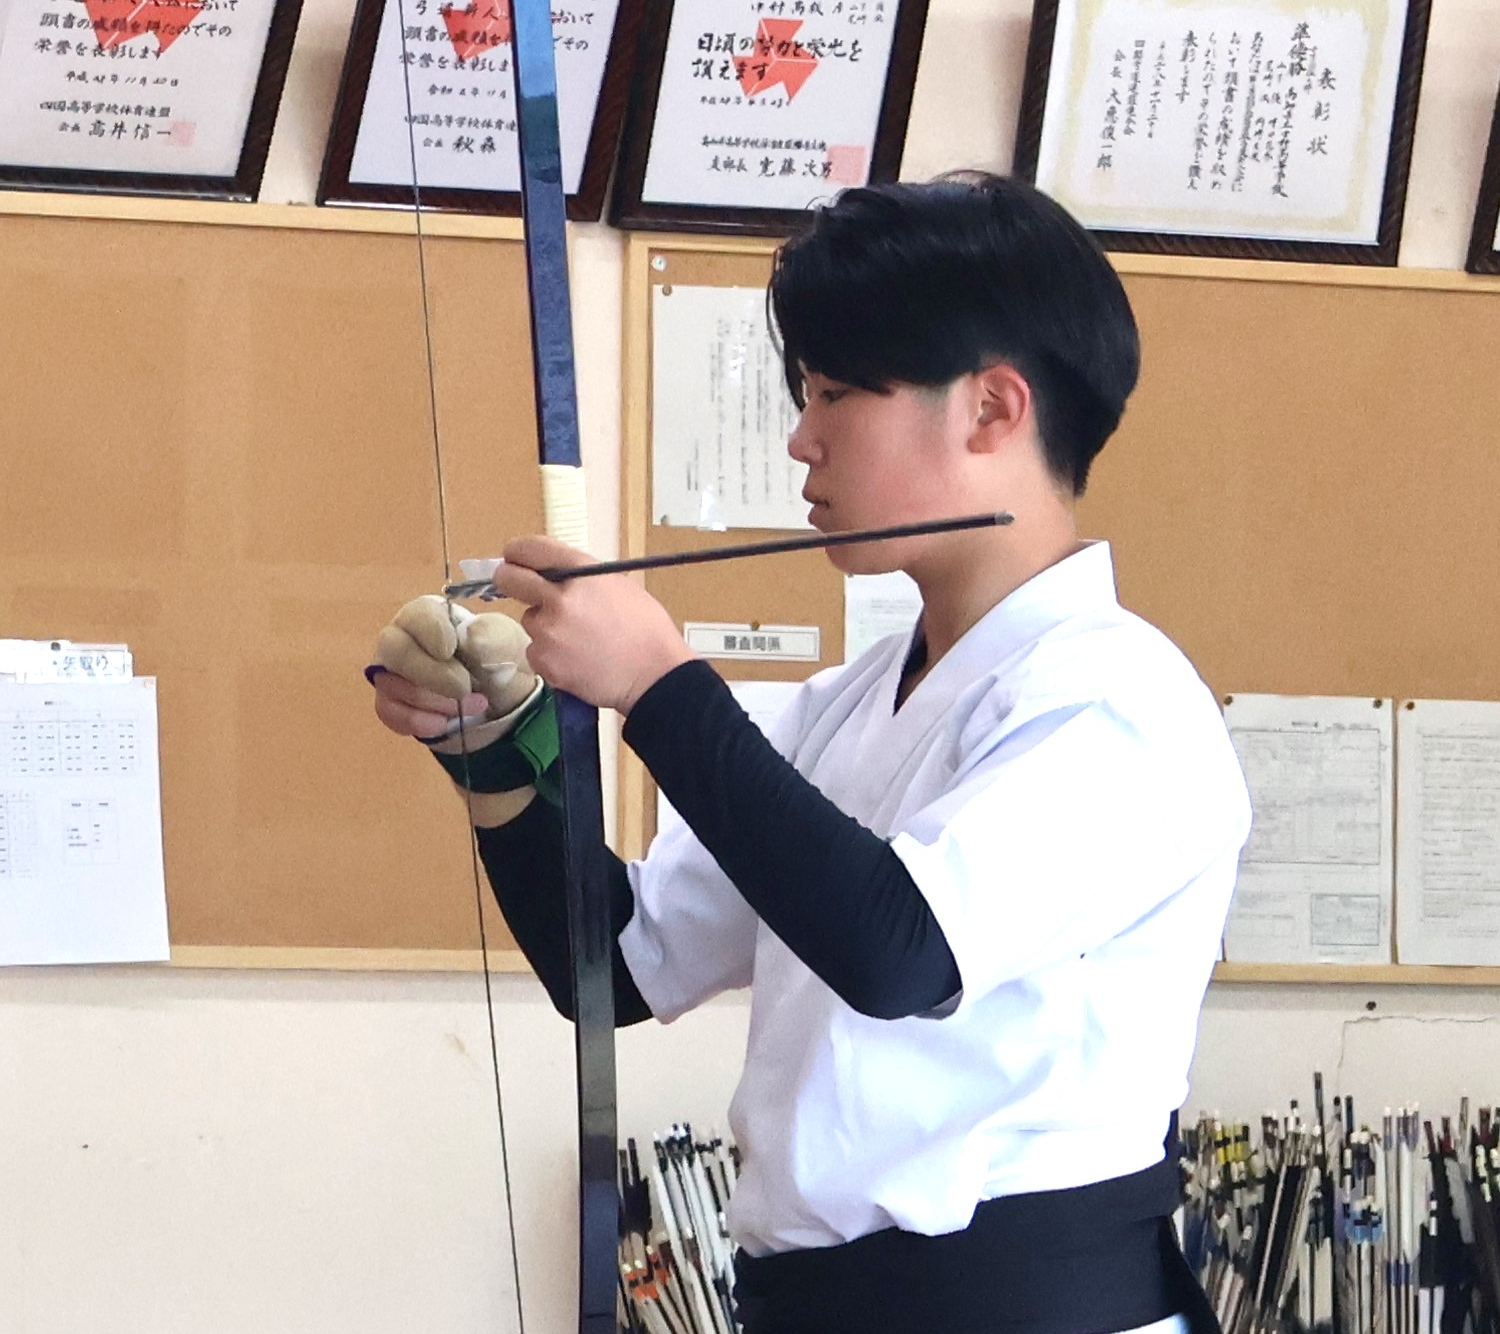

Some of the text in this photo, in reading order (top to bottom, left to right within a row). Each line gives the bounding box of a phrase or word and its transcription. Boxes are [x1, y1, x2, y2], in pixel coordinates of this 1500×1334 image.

[696, 32, 864, 63] 日頃の努力と栄光を
[1306, 67, 1337, 156] 表彰状
